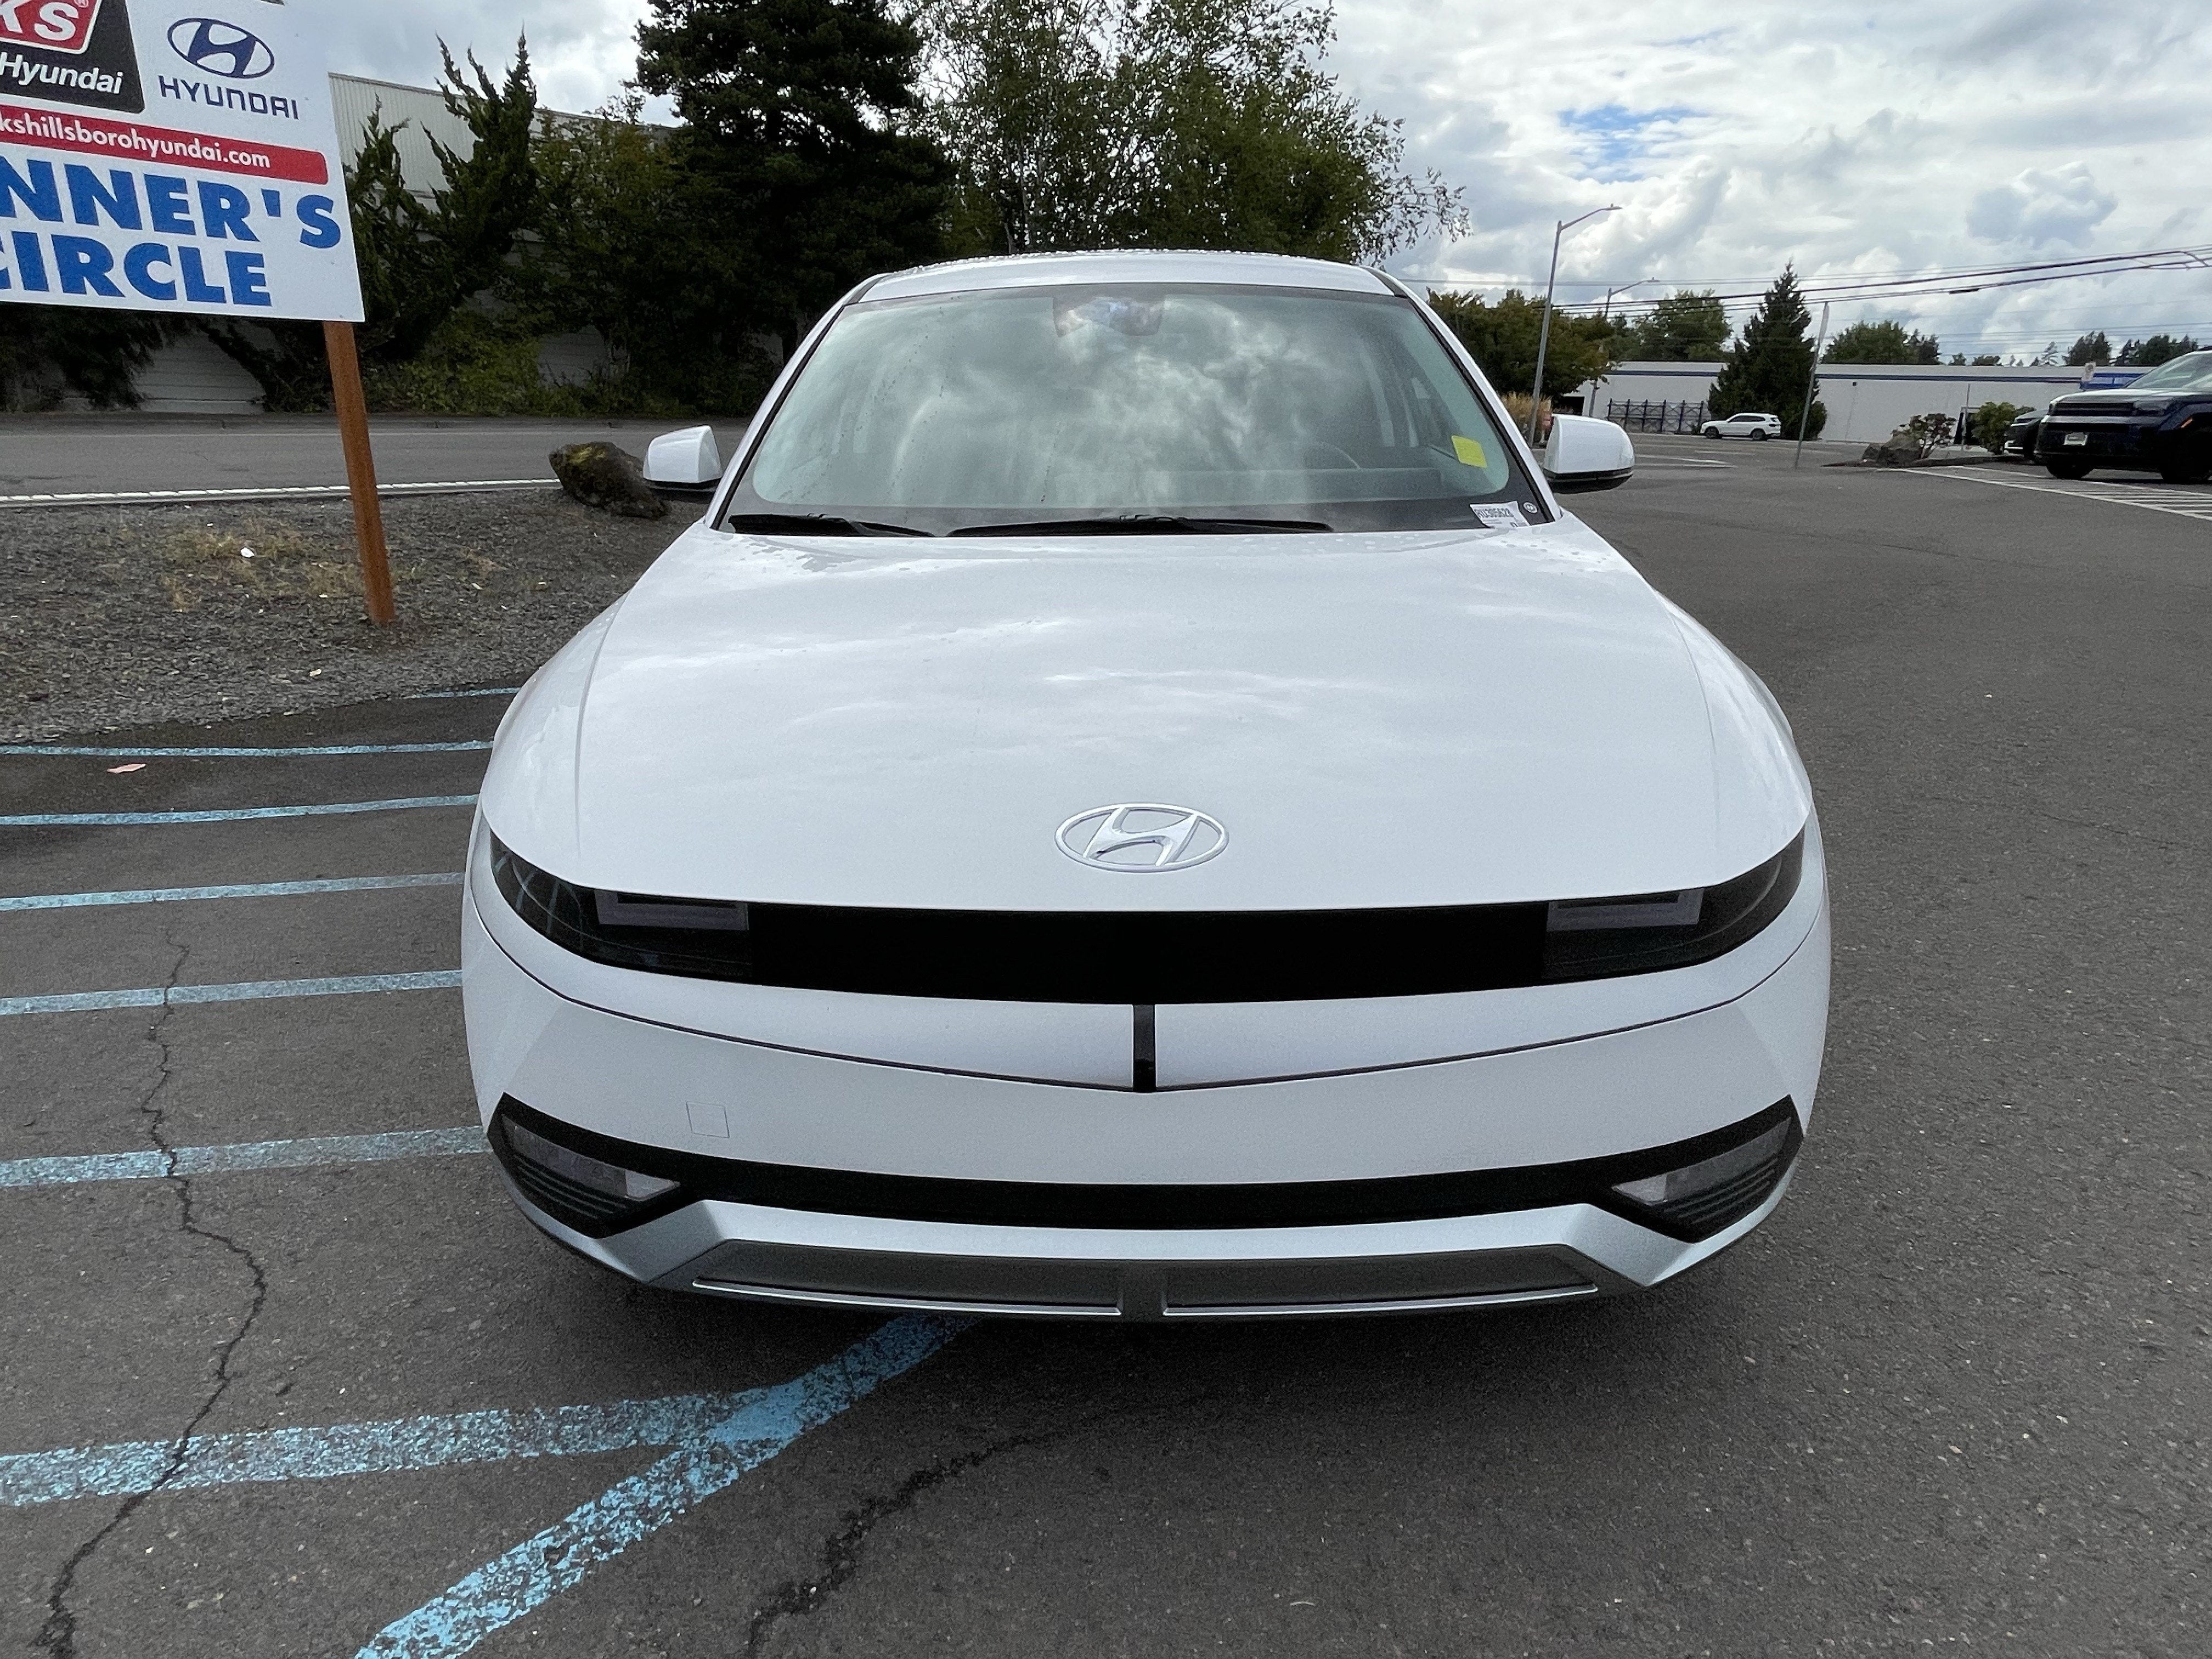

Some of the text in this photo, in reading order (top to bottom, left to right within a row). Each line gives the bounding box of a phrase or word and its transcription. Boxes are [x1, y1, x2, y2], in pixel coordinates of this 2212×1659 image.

[0, 52, 124, 94] Hyundai
[157, 75, 300, 120] HYUNDAI
[0, 156, 341, 249] NNER'S
[0, 230, 272, 307] IRCLE
